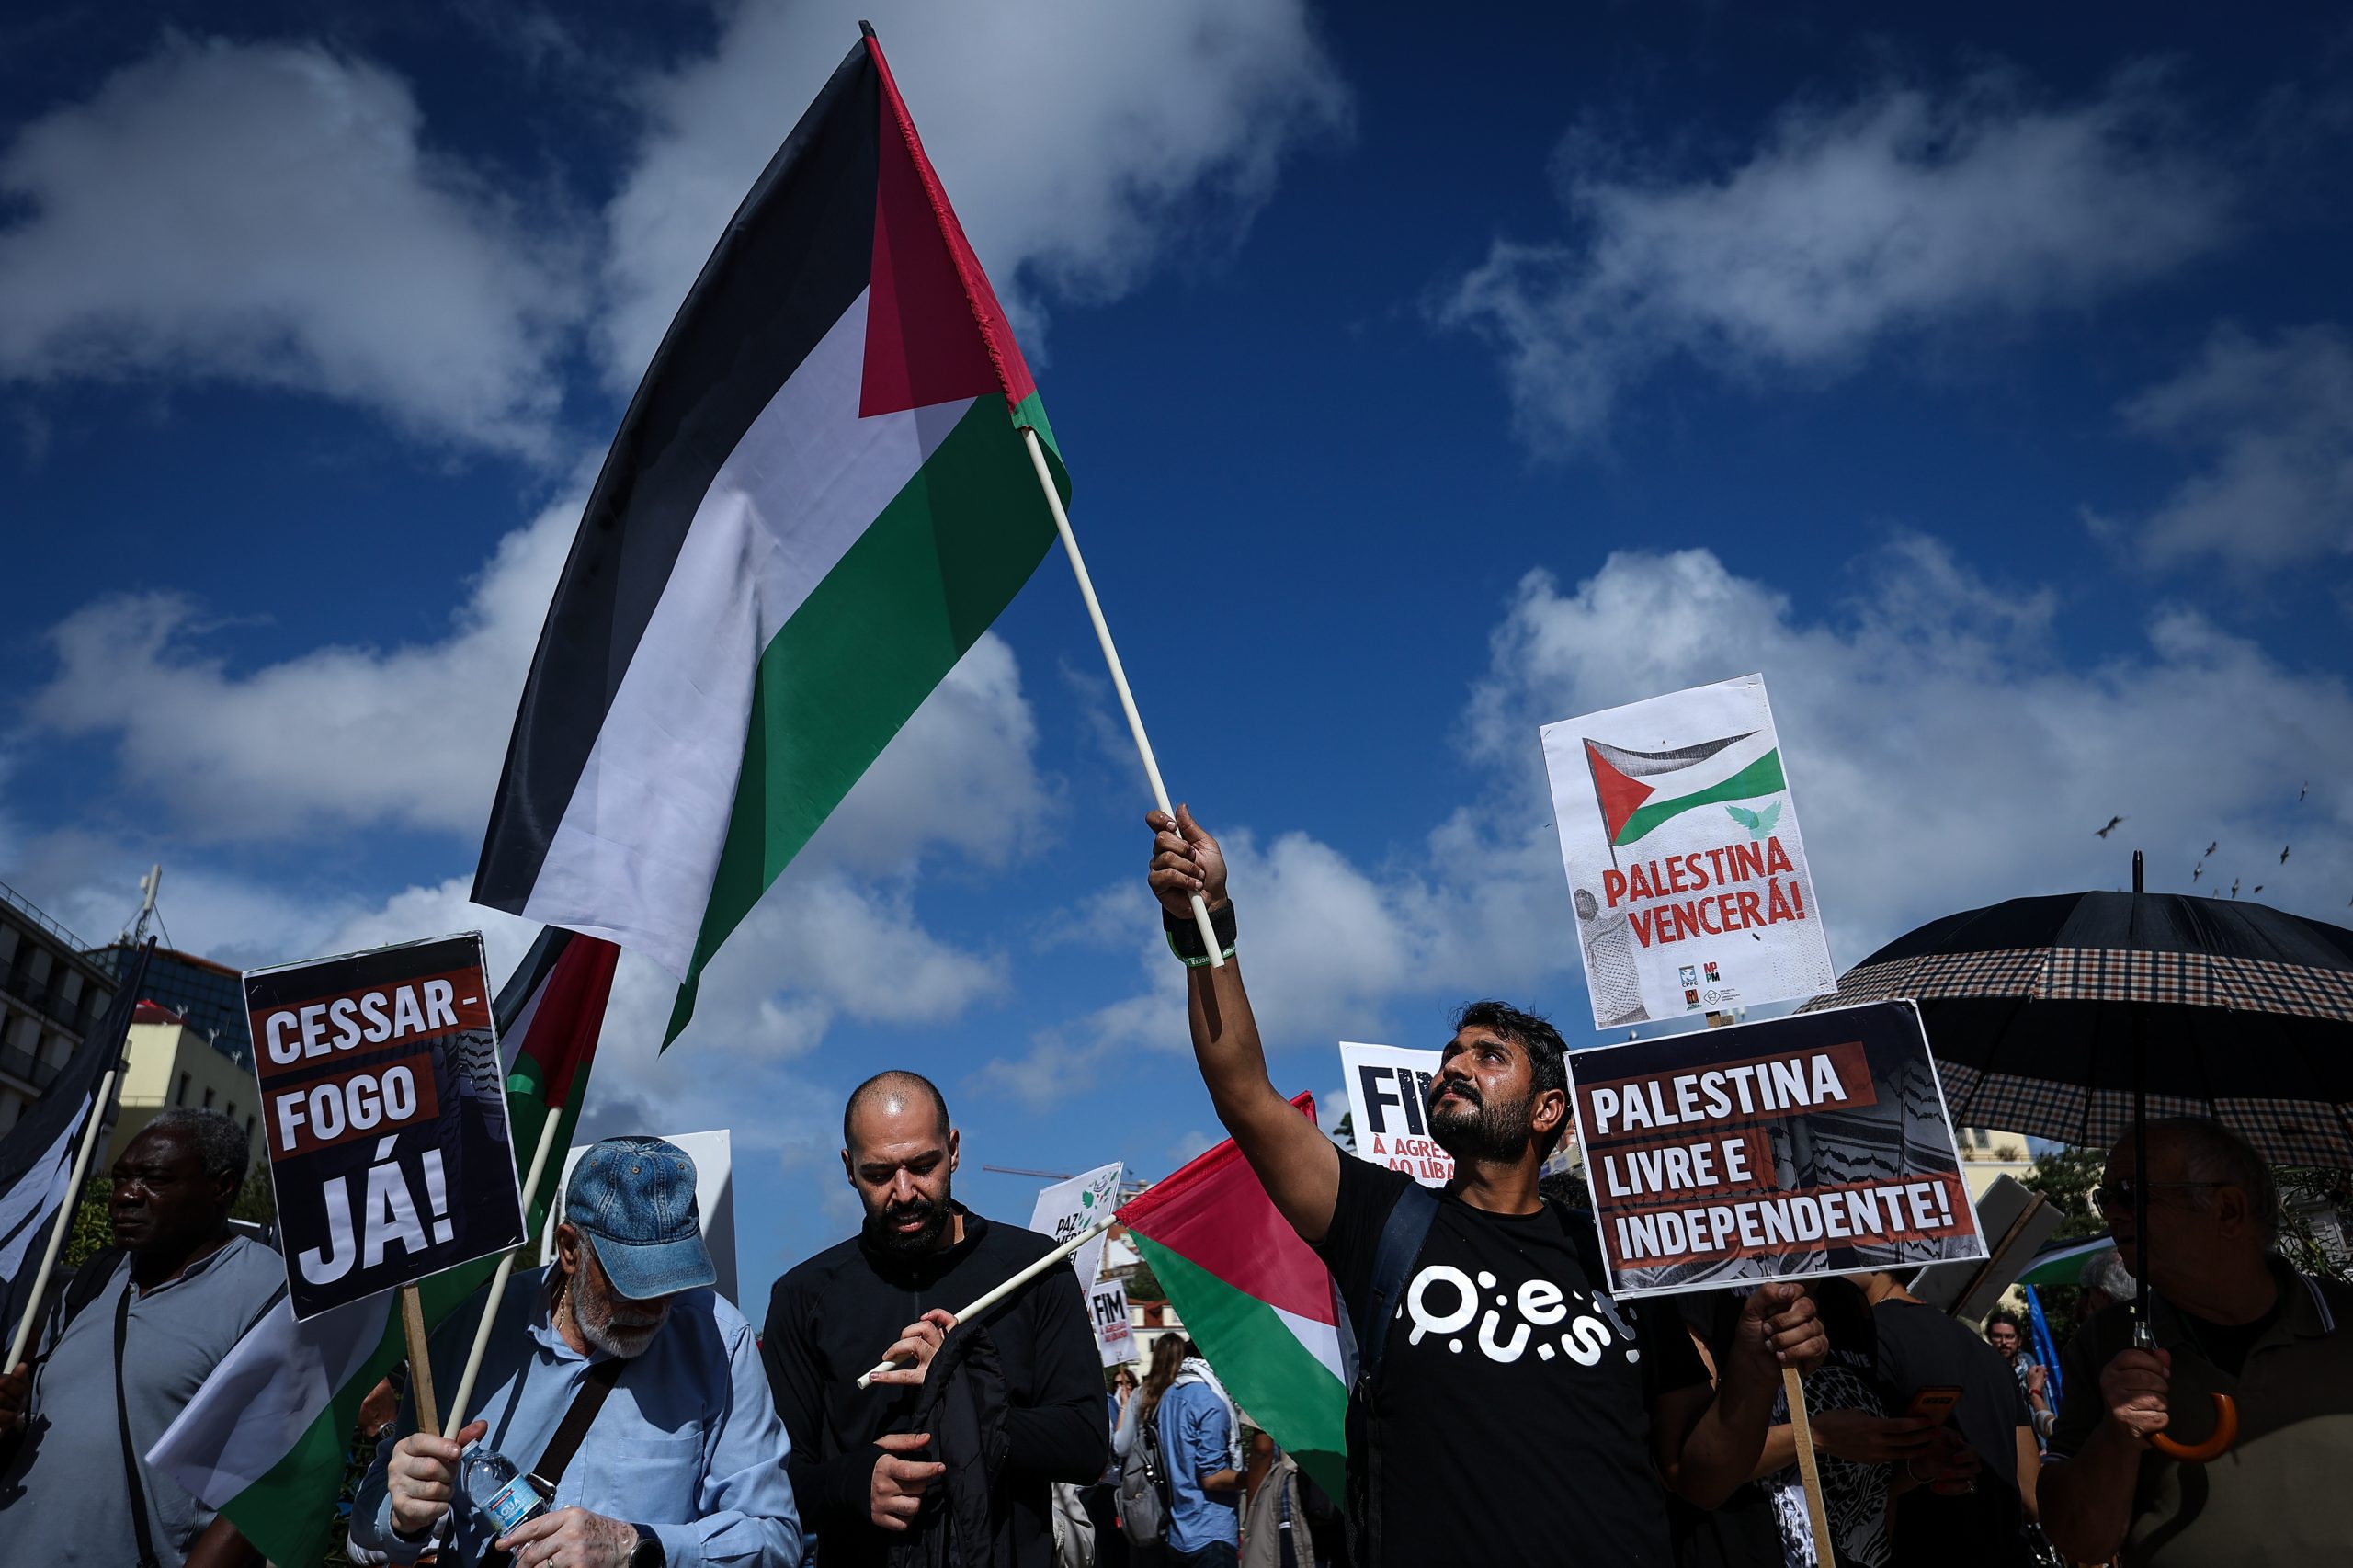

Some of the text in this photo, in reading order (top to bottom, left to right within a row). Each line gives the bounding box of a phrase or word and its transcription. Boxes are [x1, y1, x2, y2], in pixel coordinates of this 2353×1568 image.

[1603, 836, 1794, 907] PALESTINA
[1628, 877, 1805, 948] VENCERÁ!
[1191, 957, 1211, 965] OCCER
[267, 979, 477, 1064] CESSAR-
[277, 1066, 416, 1151] FOGO
[1591, 1054, 1847, 1134] PALESTINA
[1373, 1133, 1387, 1154] À
[1604, 1138, 1752, 1197] LIVRE E
[299, 1133, 454, 1284] JÁ!
[1056, 1213, 1078, 1235] PAZ
[1616, 1180, 1954, 1260] INDEPENDENTE!
[1093, 1290, 1125, 1325] FIM
